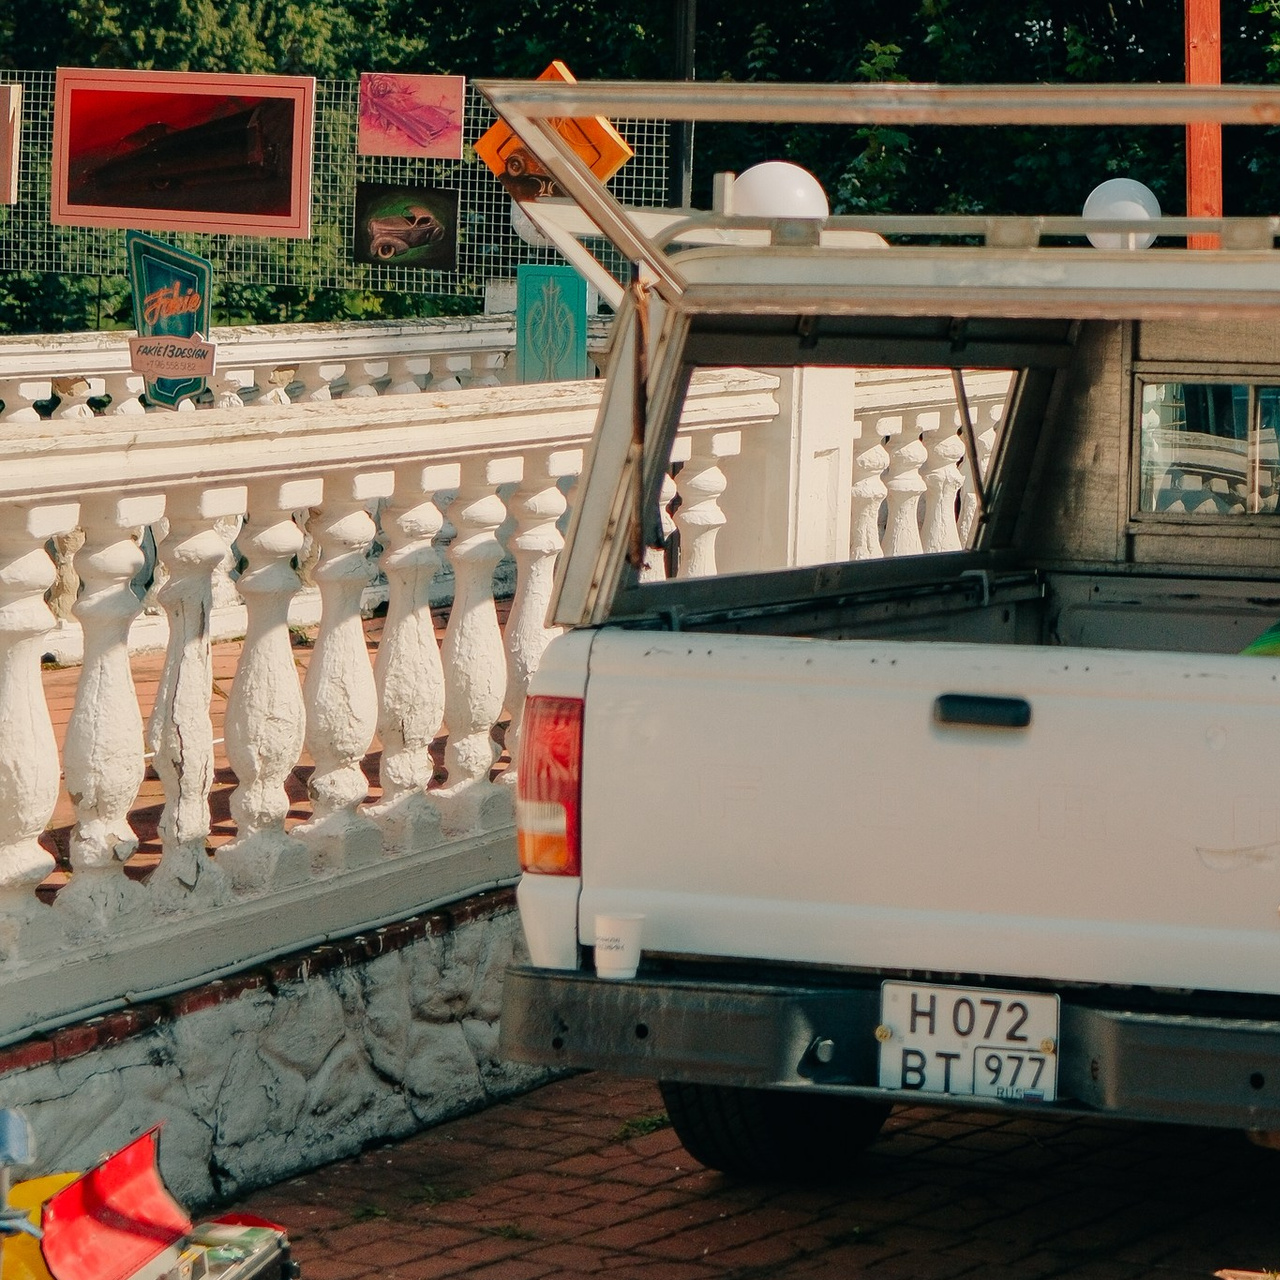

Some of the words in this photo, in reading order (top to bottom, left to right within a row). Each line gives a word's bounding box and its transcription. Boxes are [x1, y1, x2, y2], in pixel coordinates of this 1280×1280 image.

[909, 991, 936, 1035] H
[952, 996, 1029, 1042] 072
[901, 1047, 961, 1094] BT
[984, 1053, 1046, 1088] 977
